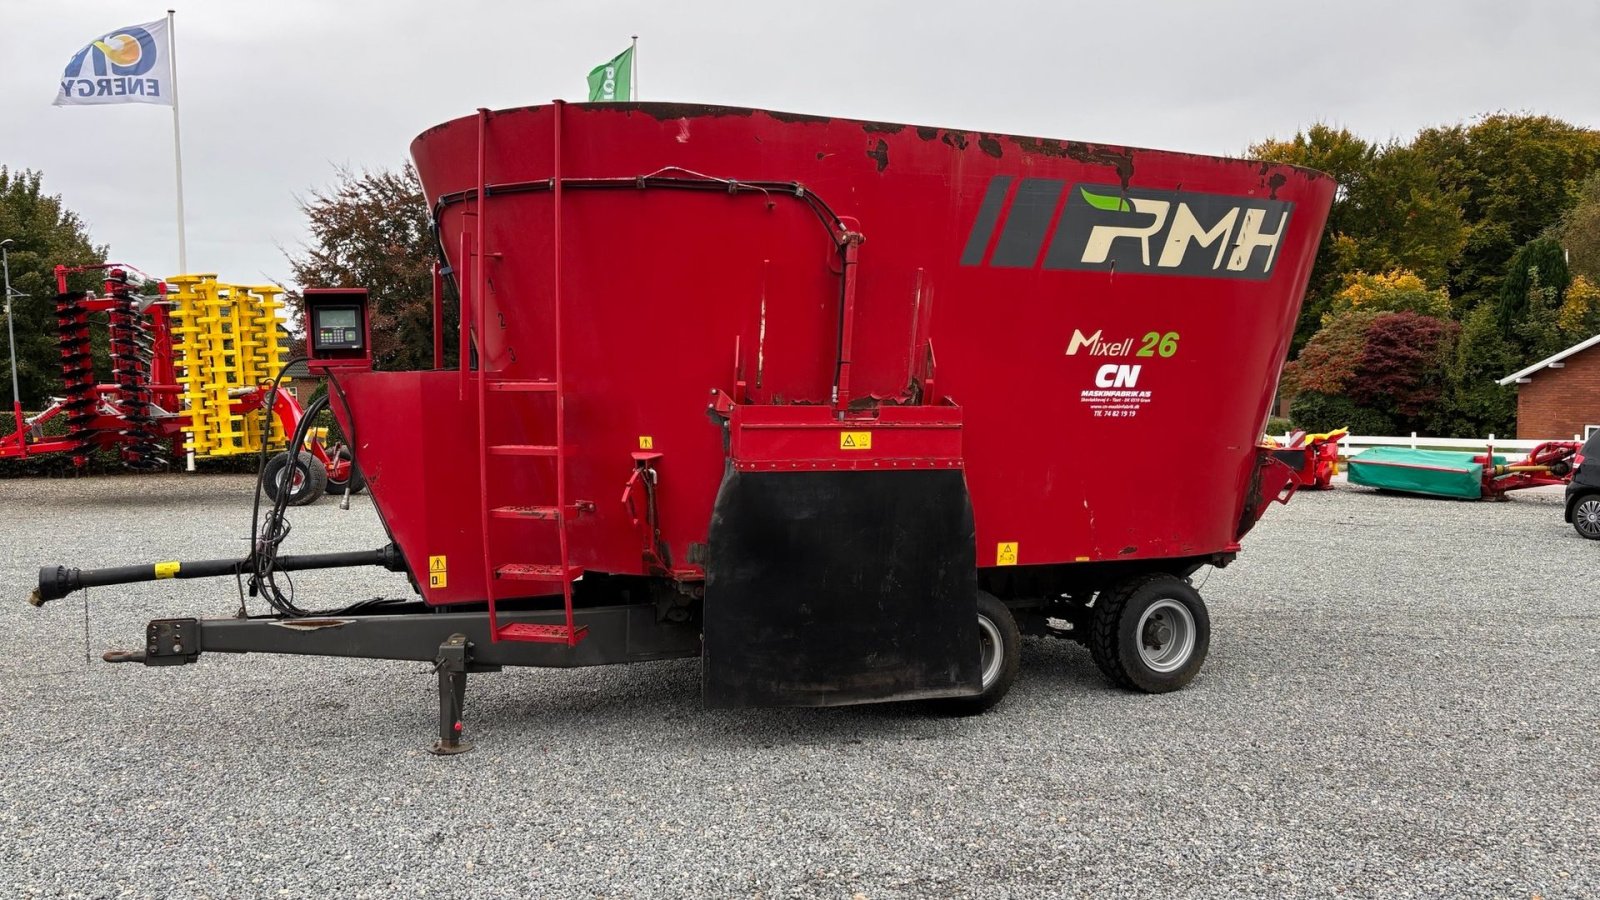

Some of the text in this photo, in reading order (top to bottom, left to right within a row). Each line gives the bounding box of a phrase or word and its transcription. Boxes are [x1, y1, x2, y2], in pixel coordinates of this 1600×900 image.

[1080, 187, 1288, 273] RMH
[498, 312, 506, 329] 2
[508, 347, 516, 362] 3
[1065, 329, 1180, 358] Mixell 26
[1095, 364, 1142, 388] CN
